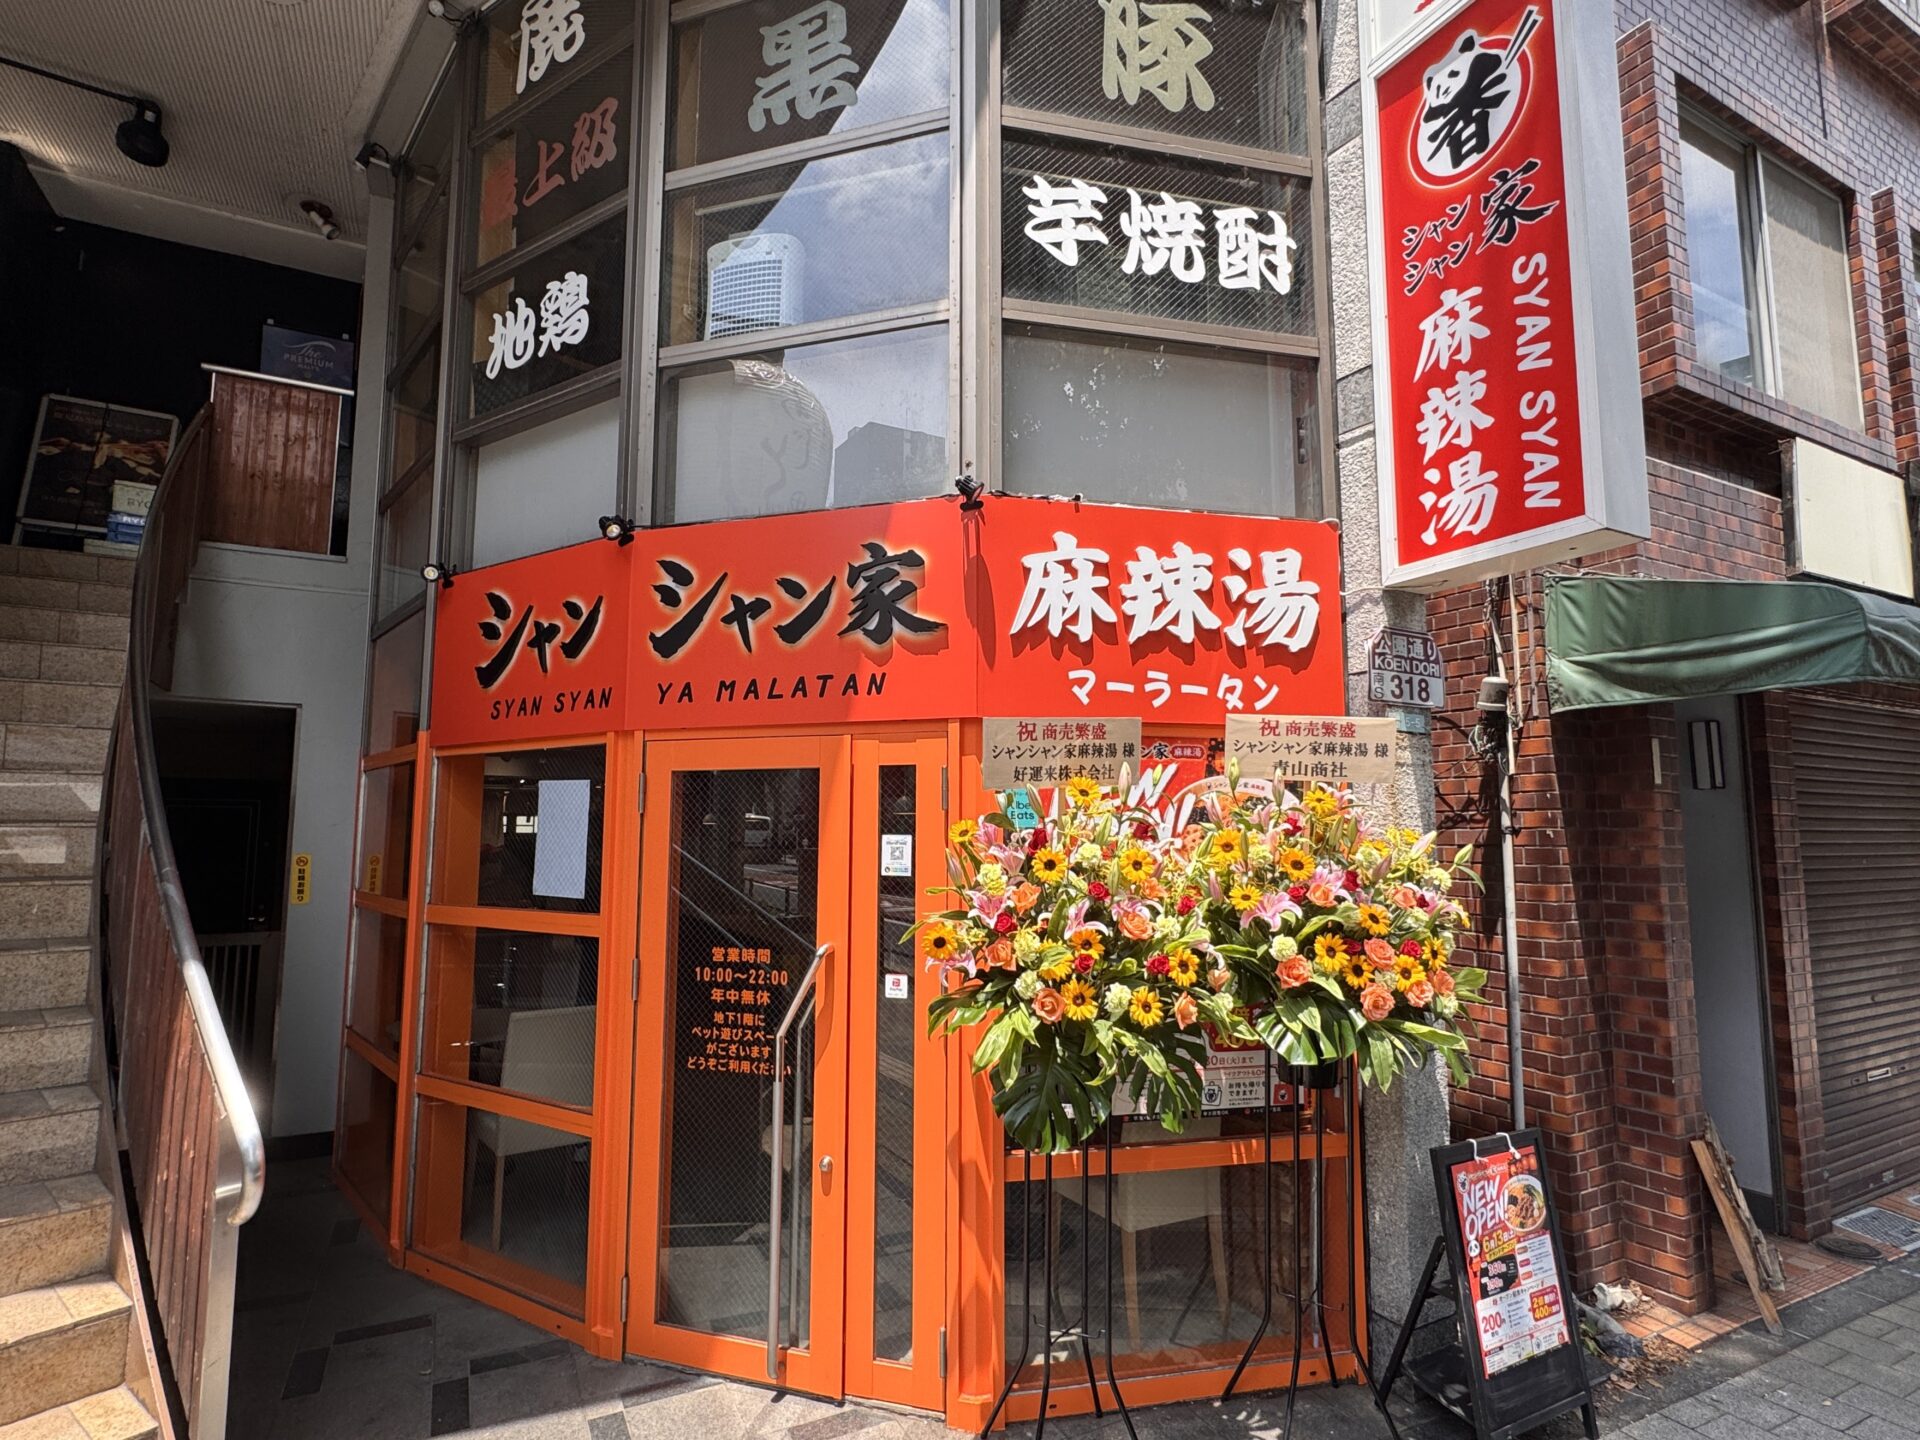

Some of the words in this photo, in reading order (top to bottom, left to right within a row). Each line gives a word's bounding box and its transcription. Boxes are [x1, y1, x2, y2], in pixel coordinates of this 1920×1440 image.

[747, 0, 860, 133] 黒
[1096, 0, 1216, 112] 豚
[1475, 158, 1561, 255] 家
[1021, 175, 1298, 296] 芋焼酎
[1401, 195, 1472, 259] シャン
[1402, 232, 1473, 296] シャン
[485, 271, 590, 380] 地鶏
[1511, 252, 1553, 371] SYAN
[1412, 286, 1500, 546] 麻辣湯
[1519, 390, 1562, 509] SYAN
[1010, 531, 1320, 653] 麻辣湯
[474, 591, 604, 689] シャン
[648, 541, 950, 662] シャン家
[1374, 632, 1437, 660] 公園通り
[1412, 661, 1440, 677] DORI
[490, 696, 543, 721] SYAN
[554, 687, 613, 715] SYAN
[657, 682, 694, 706] YA
[716, 672, 887, 702] MALATAN
[1066, 668, 1281, 712] マーラータン
[1374, 687, 1384, 699] S
[1390, 674, 1431, 702] 318
[1016, 722, 1037, 742] 祝
[1042, 723, 1107, 741] 商売繁盛
[1259, 719, 1280, 737] 祝
[1286, 721, 1357, 739] 商売繁盛
[992, 743, 1118, 760] シャンシャン家麻辣湯
[1123, 742, 1135, 757] 様
[1233, 739, 1369, 758] シャンシャン家麻辣湯
[1374, 743, 1389, 758] 様
[1013, 764, 1115, 783] 好運来株式会社
[1010, 810, 1036, 820] Eats
[711, 946, 771, 964] 営業時間
[710, 988, 771, 1006] 年中無休
[691, 1026, 789, 1044] ペット遊びスペー
[713, 1011, 766, 1027] 地下1階に
[706, 1042, 772, 1059] がございます
[1463, 1175, 1501, 1218] NEW
